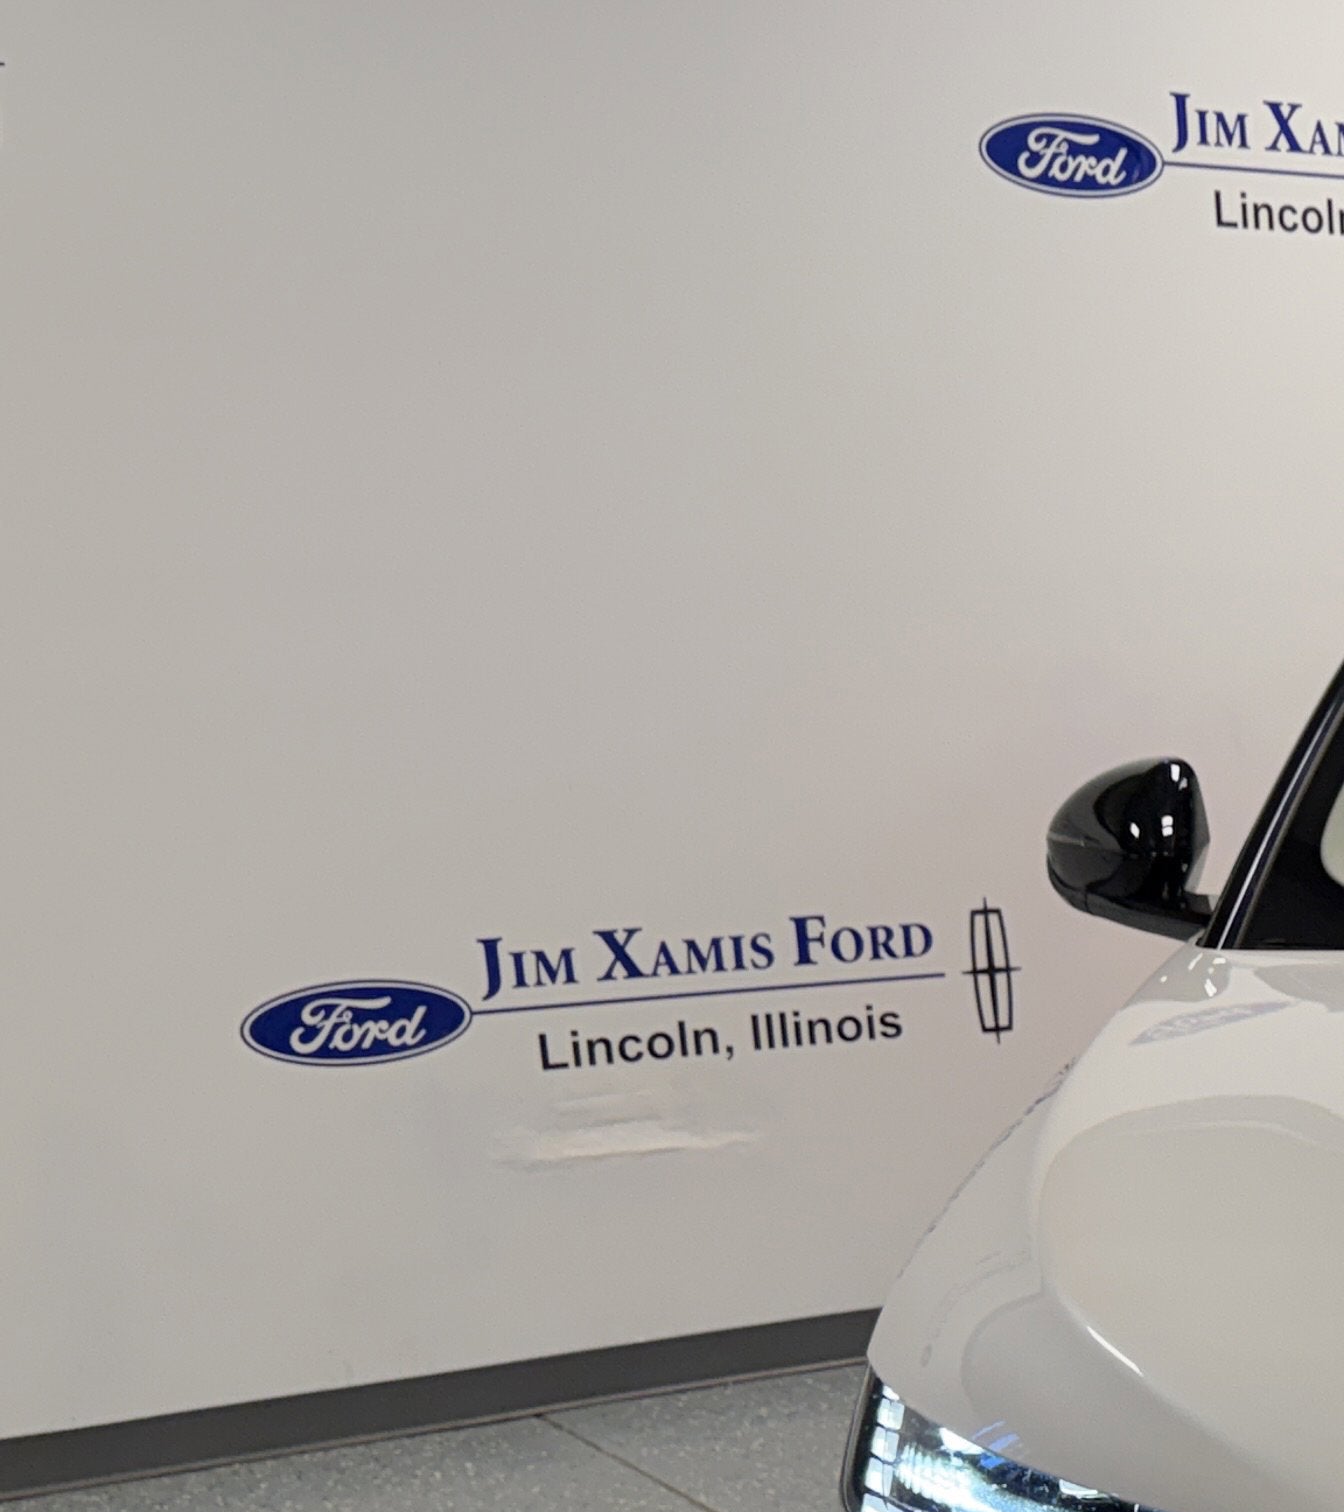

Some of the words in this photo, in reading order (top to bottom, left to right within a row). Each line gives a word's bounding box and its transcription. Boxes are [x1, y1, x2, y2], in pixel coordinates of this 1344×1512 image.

[1169, 92, 1249, 152] JIM
[1017, 127, 1127, 187] Ford
[477, 936, 580, 1001] JIM
[594, 929, 774, 981] XAMIS
[790, 915, 933, 967] FORD
[289, 996, 427, 1055] Ford
[538, 1020, 735, 1070] Lincoln,
[750, 1004, 903, 1049] Illinois
